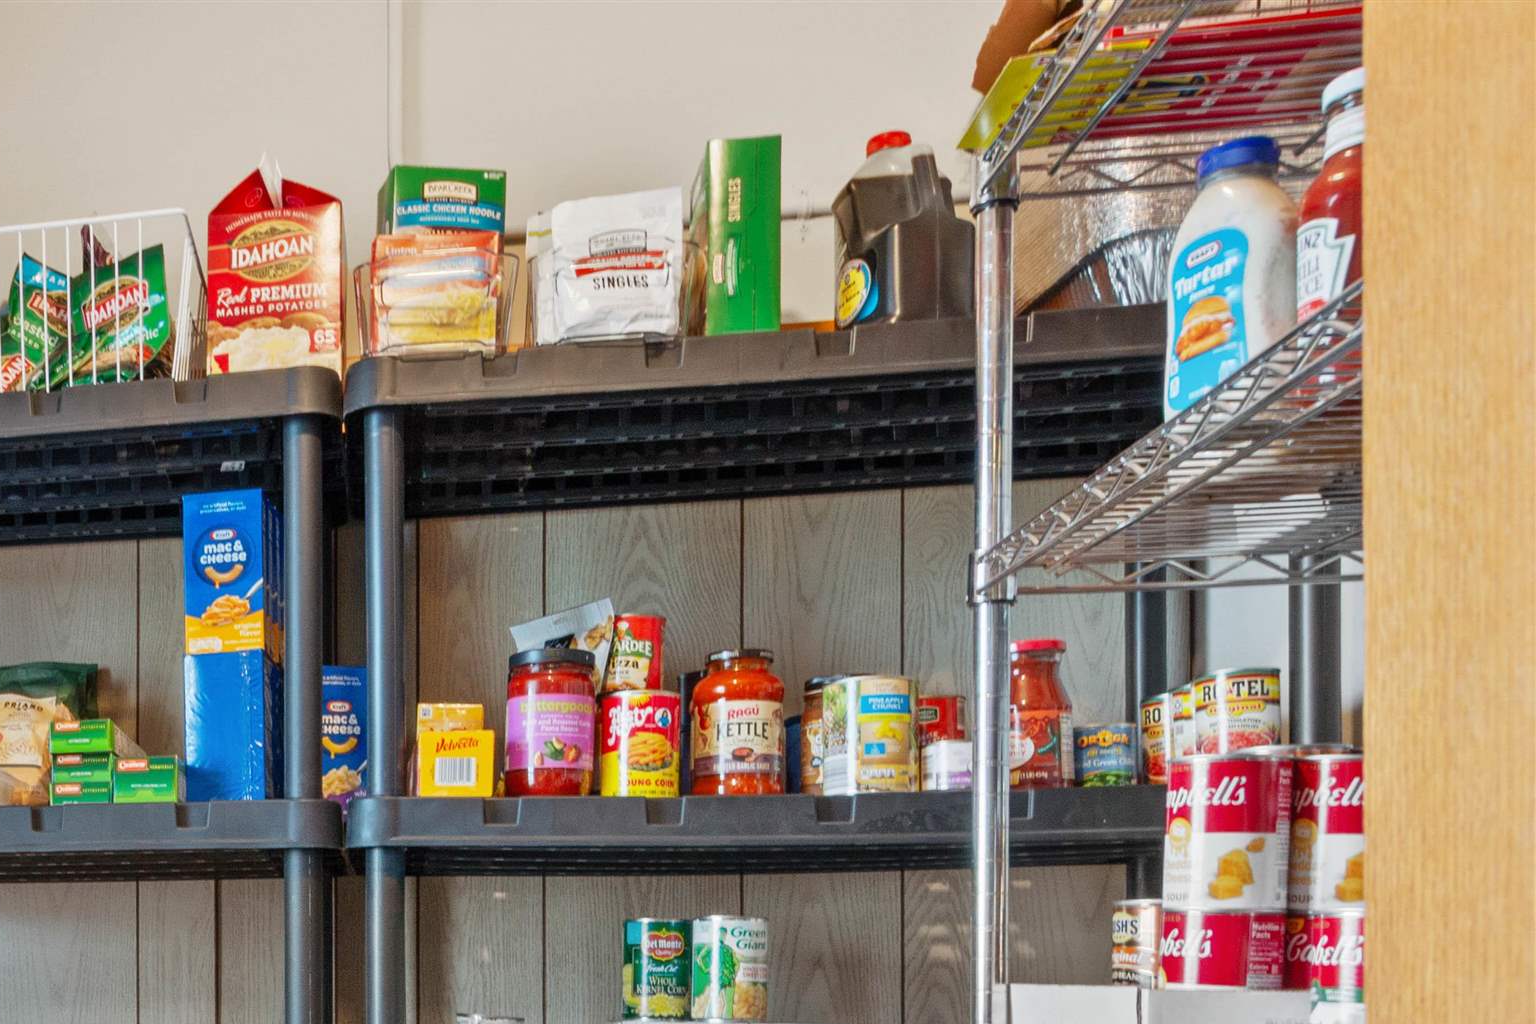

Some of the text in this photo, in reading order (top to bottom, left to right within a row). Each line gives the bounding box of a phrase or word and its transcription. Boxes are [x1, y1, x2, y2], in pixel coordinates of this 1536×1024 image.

[396, 204, 430, 217] CLASSIC
[432, 203, 467, 216] CHICKEN
[468, 205, 502, 220] NOODLE
[231, 235, 313, 269] IDAHOAN
[592, 274, 650, 290] SINGLES
[1175, 255, 1239, 299] Tartar
[250, 283, 328, 302] PREMIUM
[84, 282, 147, 328] IDAHOAN
[216, 301, 328, 318] MASHED POTATOES
[314, 328, 336, 344] 65
[204, 540, 244, 554] mac &
[322, 714, 358, 724] mac &
[435, 736, 480, 753] Velveeta
[1167, 776, 1247, 815] mpbell's
[730, 927, 766, 938] Green
